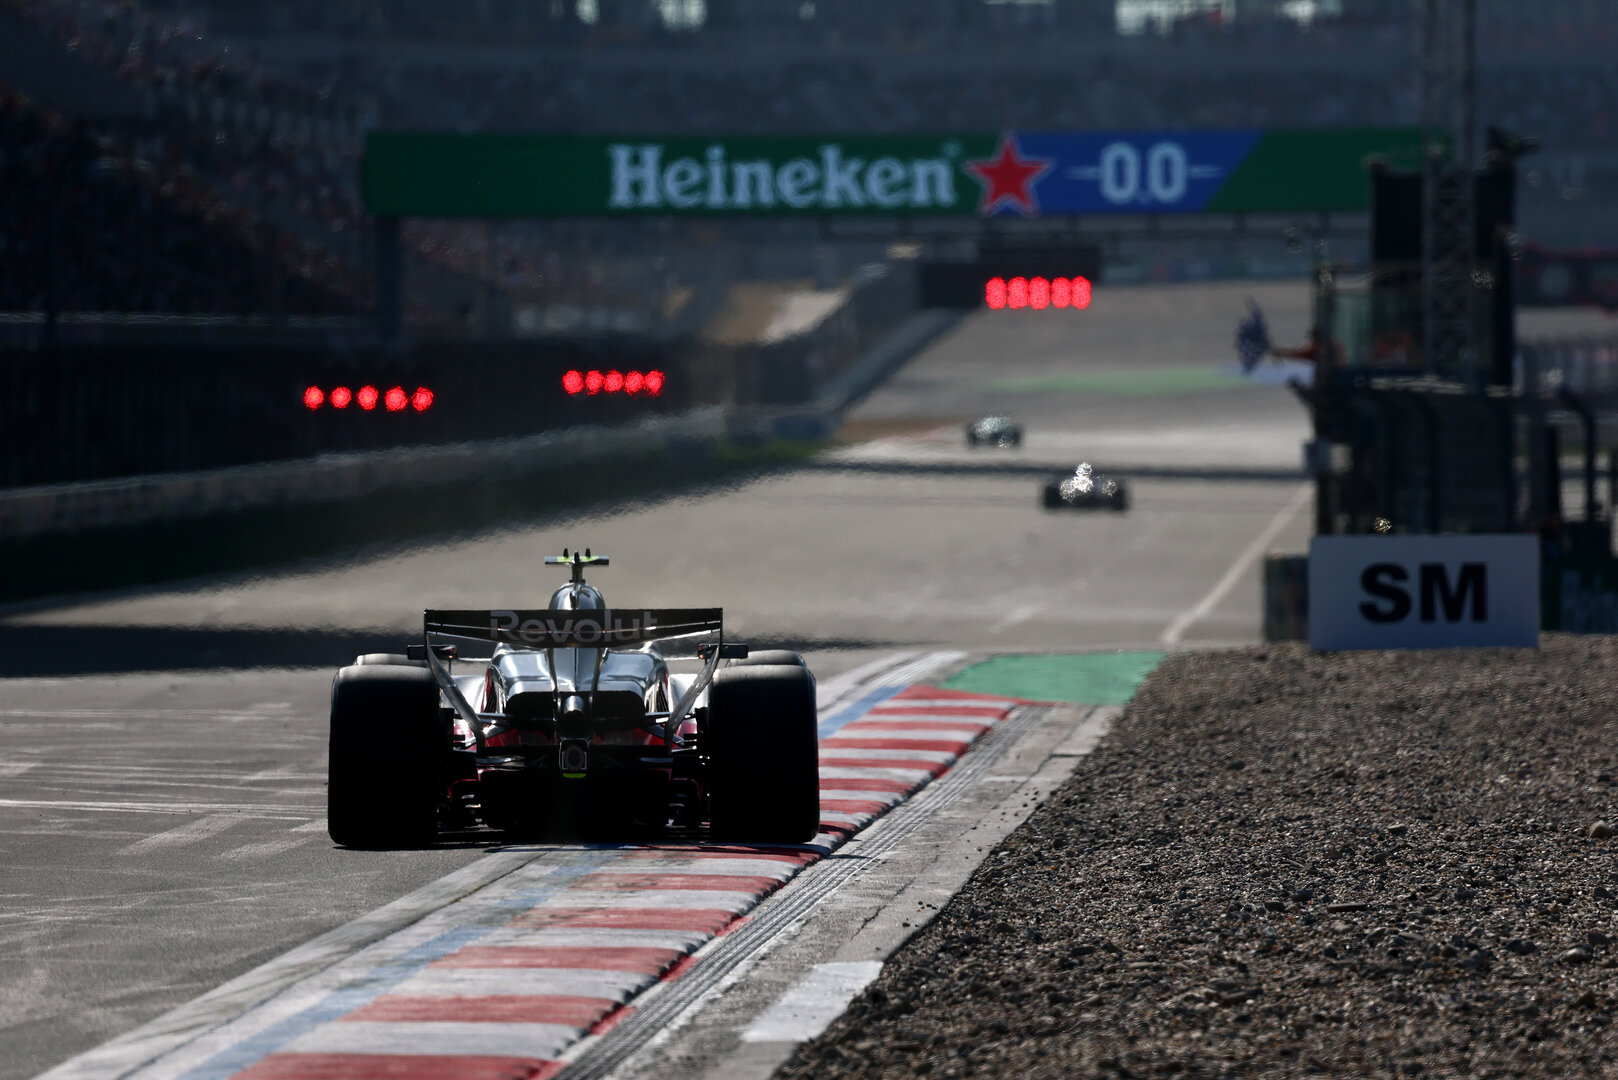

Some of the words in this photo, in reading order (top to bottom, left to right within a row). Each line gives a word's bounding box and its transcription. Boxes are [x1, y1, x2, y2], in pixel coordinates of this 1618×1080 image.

[607, 143, 956, 208] Heineken
[1359, 563, 1486, 622] SM
[490, 610, 658, 643] Revolut
